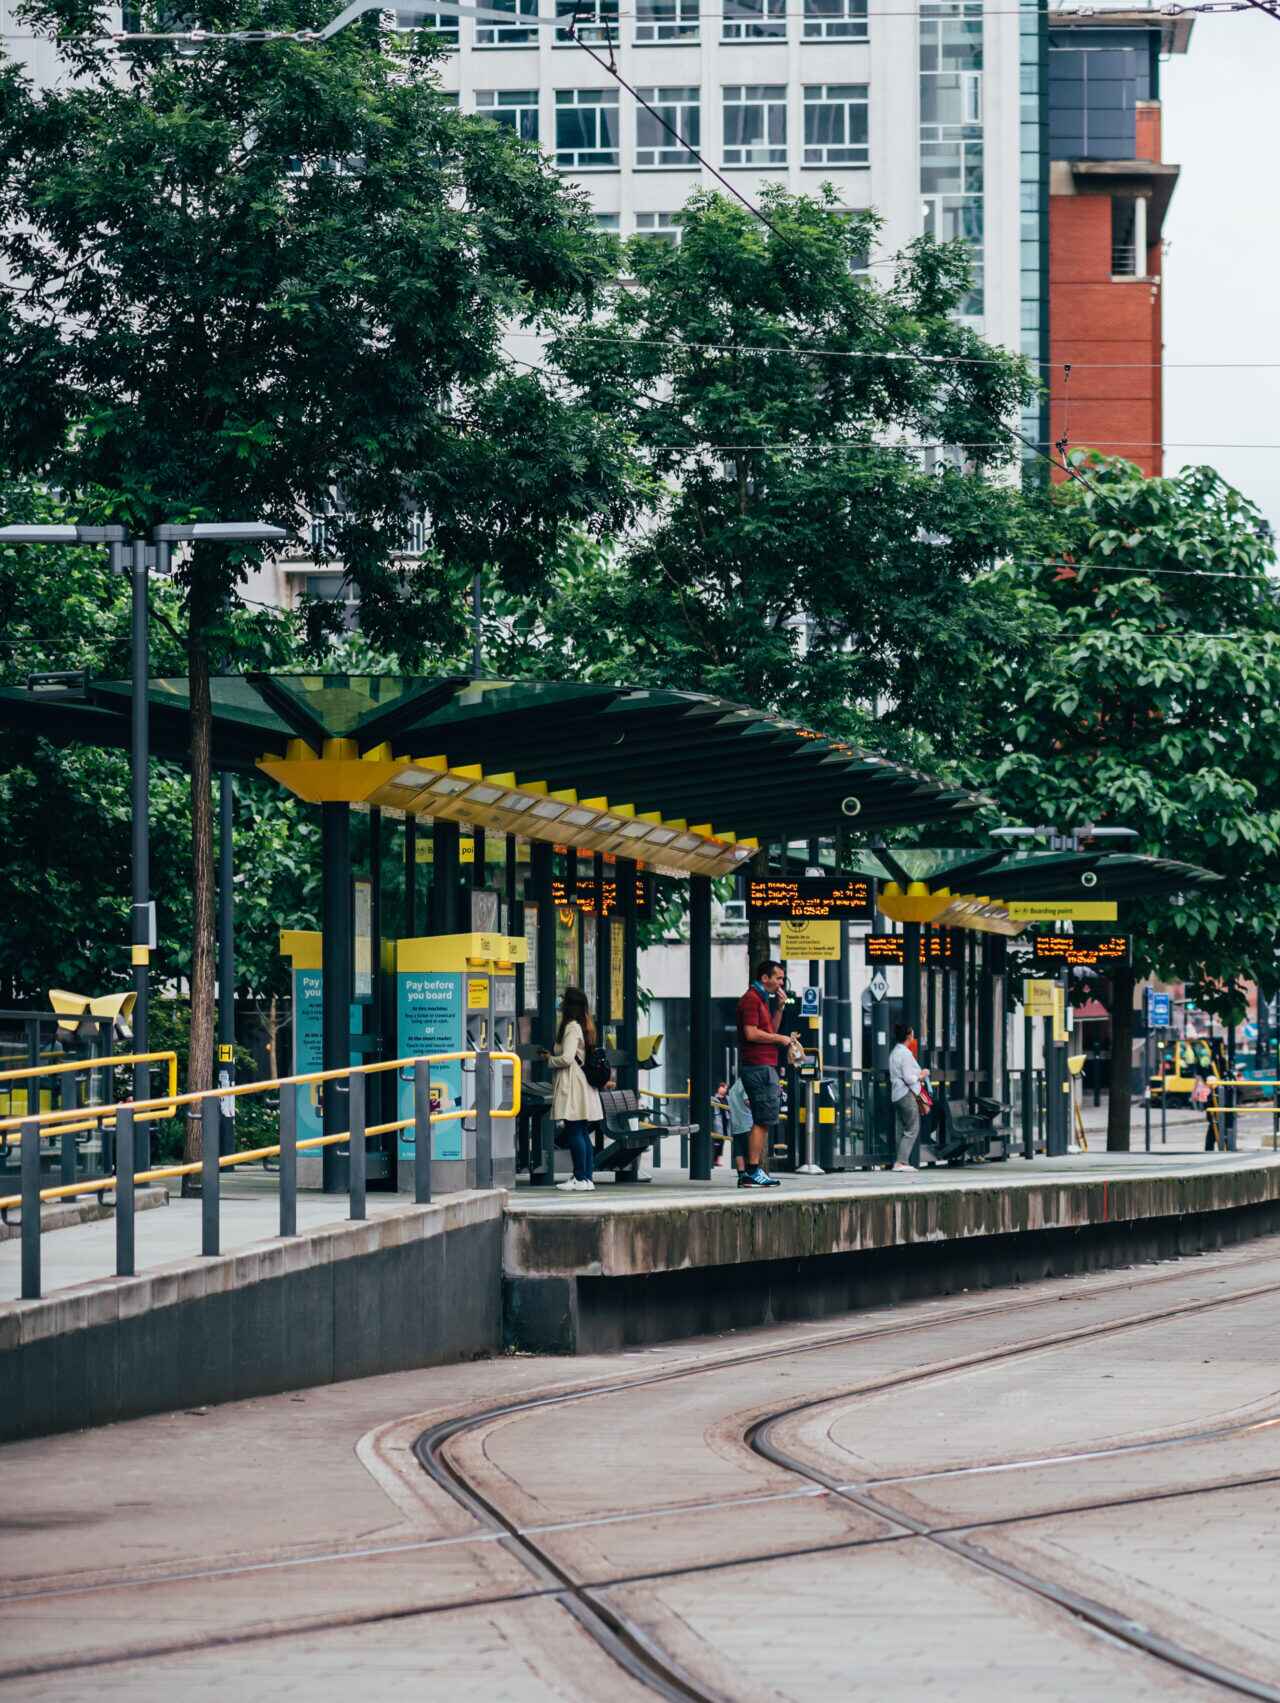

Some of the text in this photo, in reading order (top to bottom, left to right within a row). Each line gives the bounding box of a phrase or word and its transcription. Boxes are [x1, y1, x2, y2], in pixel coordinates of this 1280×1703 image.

[461, 846, 474, 855] poi
[1030, 908, 1056, 916] Boarding
[303, 977, 320, 989] Pay
[406, 980, 455, 991] Pay before
[873, 982, 885, 991] 10
[304, 988, 321, 1000] you
[407, 991, 453, 1002] you board
[425, 1026, 435, 1034] or
[220, 1046, 231, 1061] H
